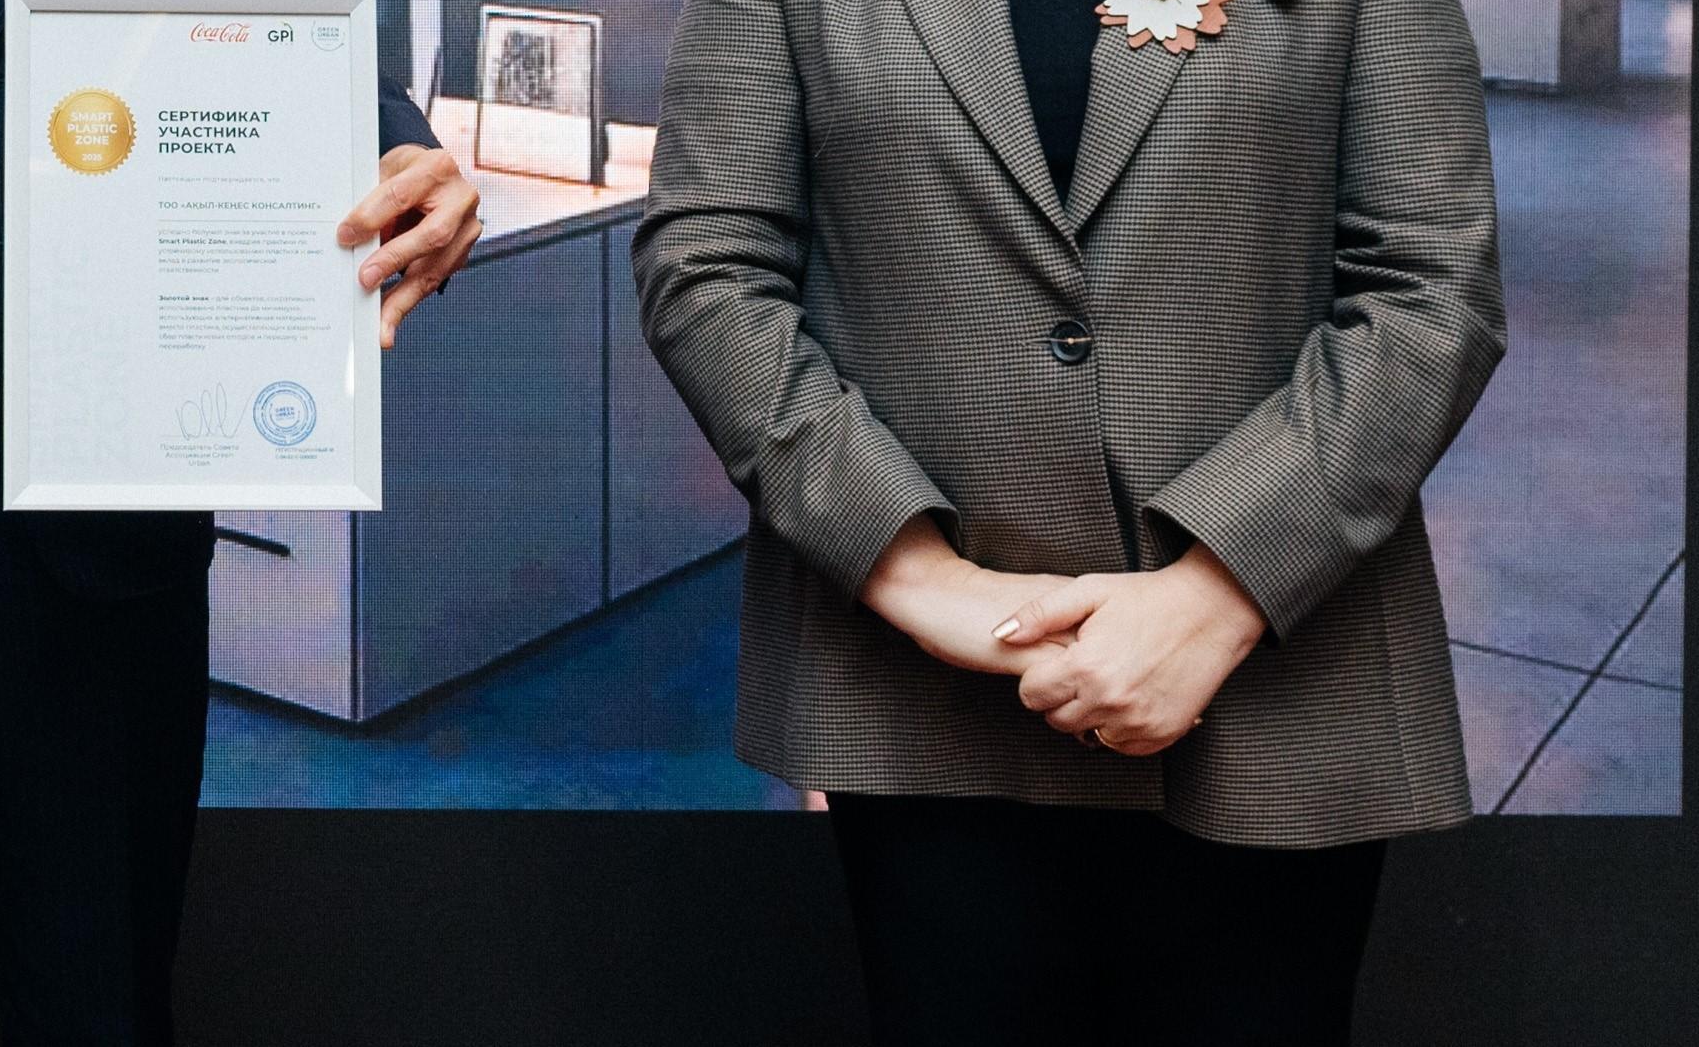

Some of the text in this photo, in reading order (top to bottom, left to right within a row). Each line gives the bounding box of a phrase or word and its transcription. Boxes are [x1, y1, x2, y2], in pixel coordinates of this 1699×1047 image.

[267, 30, 294, 43] GPI
[70, 111, 114, 123] SMART
[158, 110, 271, 123] СЕРТИФИКАТ
[67, 123, 118, 134] PLASTIC
[158, 126, 261, 139] УЧАСТНИКА
[75, 135, 110, 145] ZONE
[158, 142, 237, 154] ПРОЕКТА
[158, 201, 179, 210] ТОО
